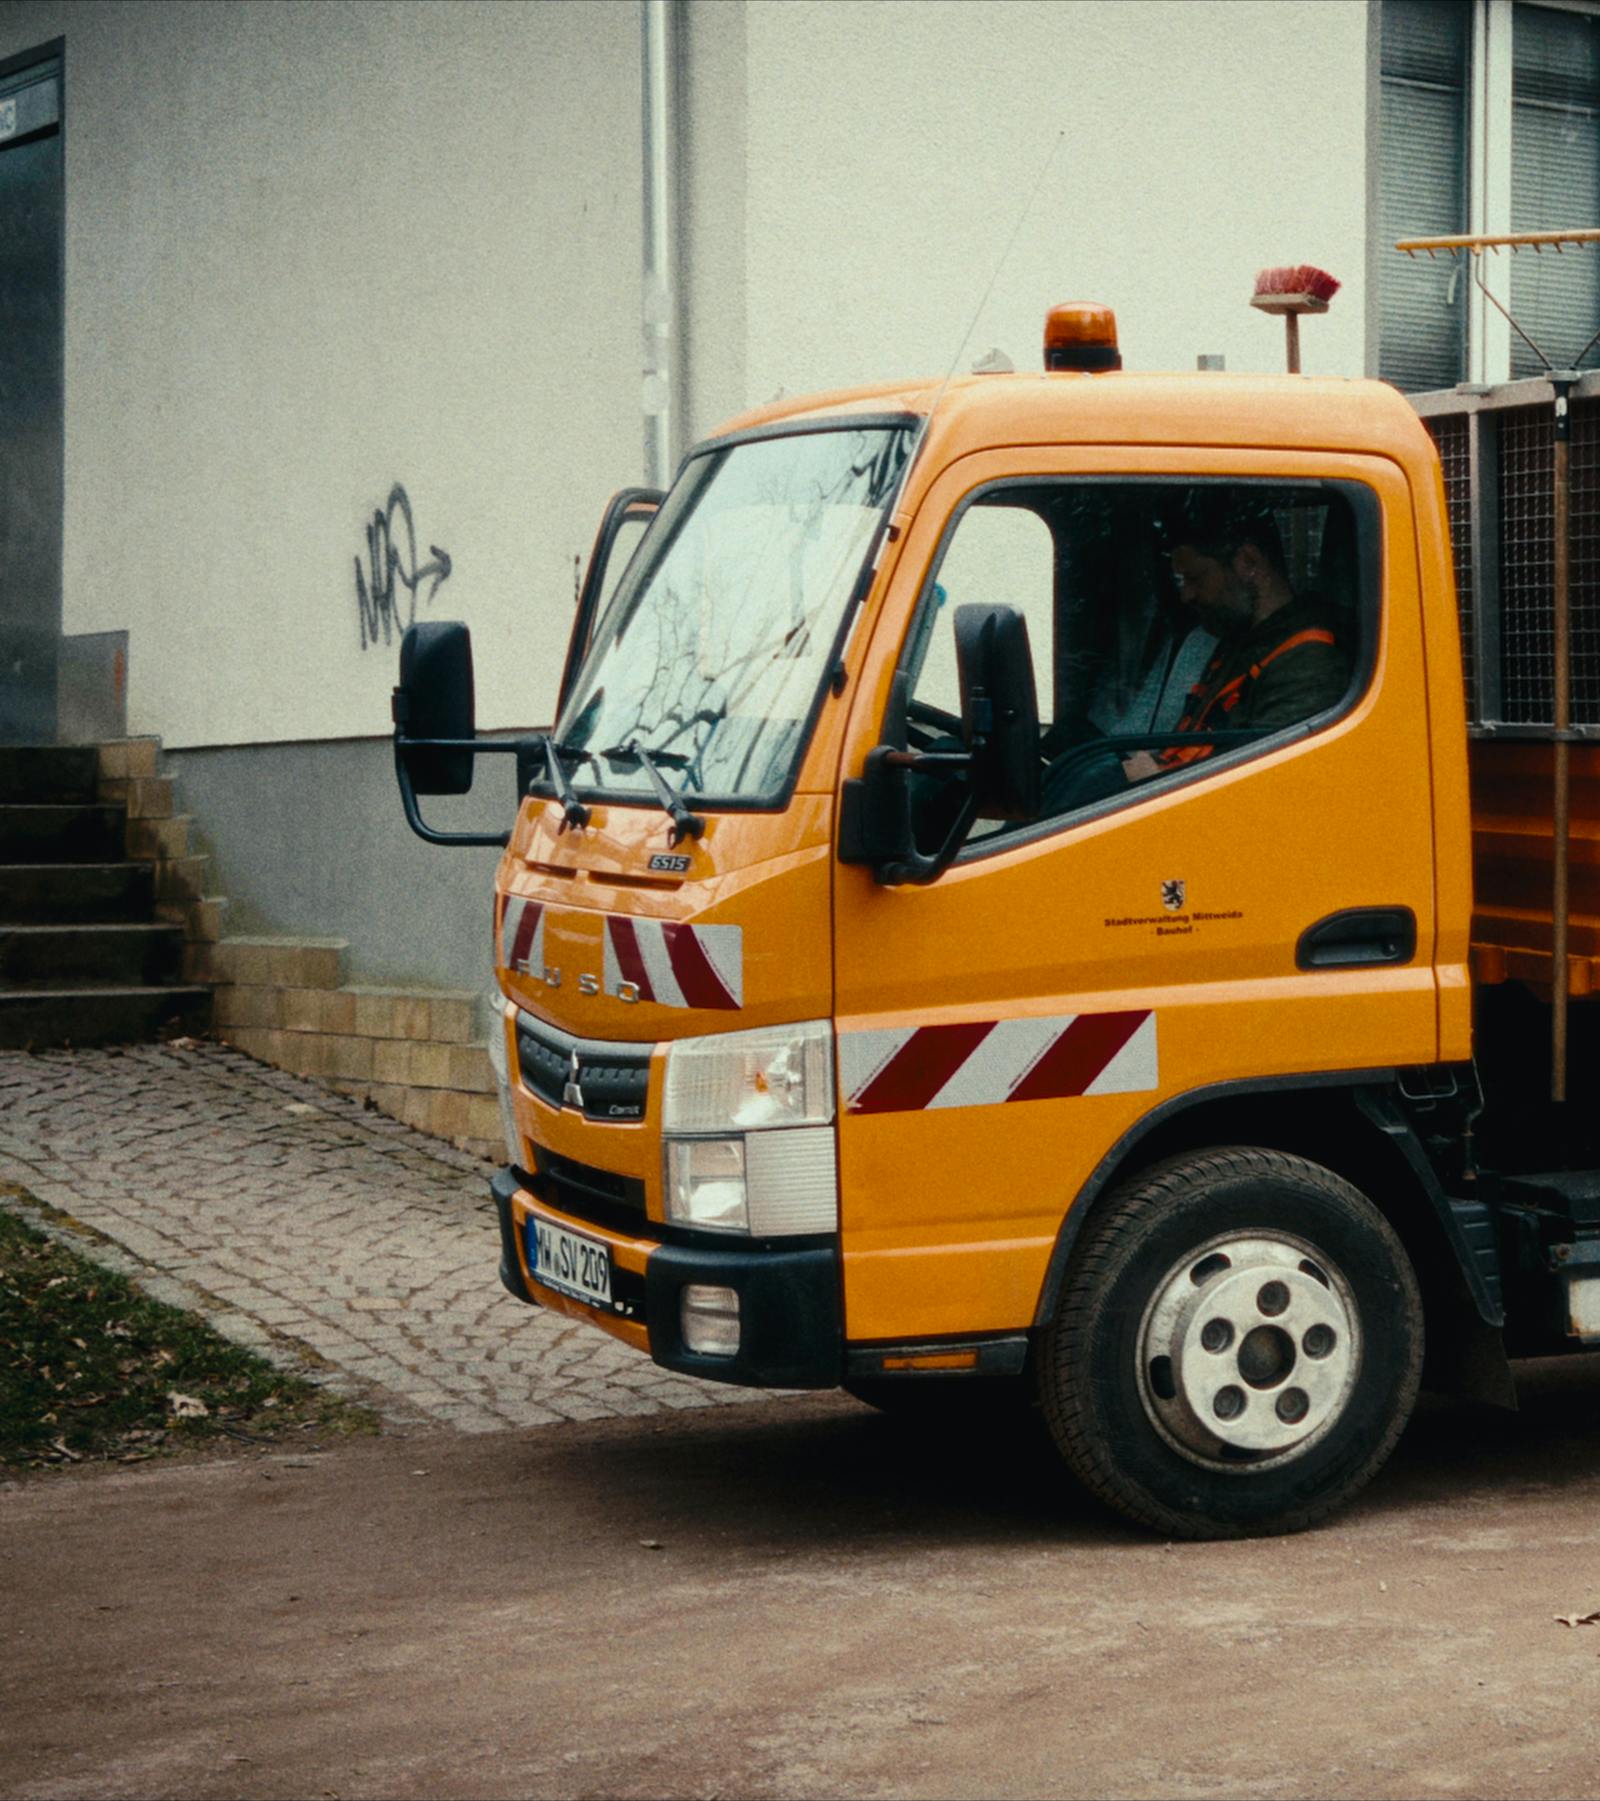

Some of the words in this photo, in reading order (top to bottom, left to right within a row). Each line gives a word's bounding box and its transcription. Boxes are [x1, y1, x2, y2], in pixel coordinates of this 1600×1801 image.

[1104, 914, 1189, 927] Stadtverwaltung
[1192, 911, 1243, 922] Mittweida
[1156, 926, 1193, 936] Bauhof
[517, 957, 640, 1004] FUSO
[560, 1235, 577, 1282] SV
[580, 1243, 608, 1295] 209
